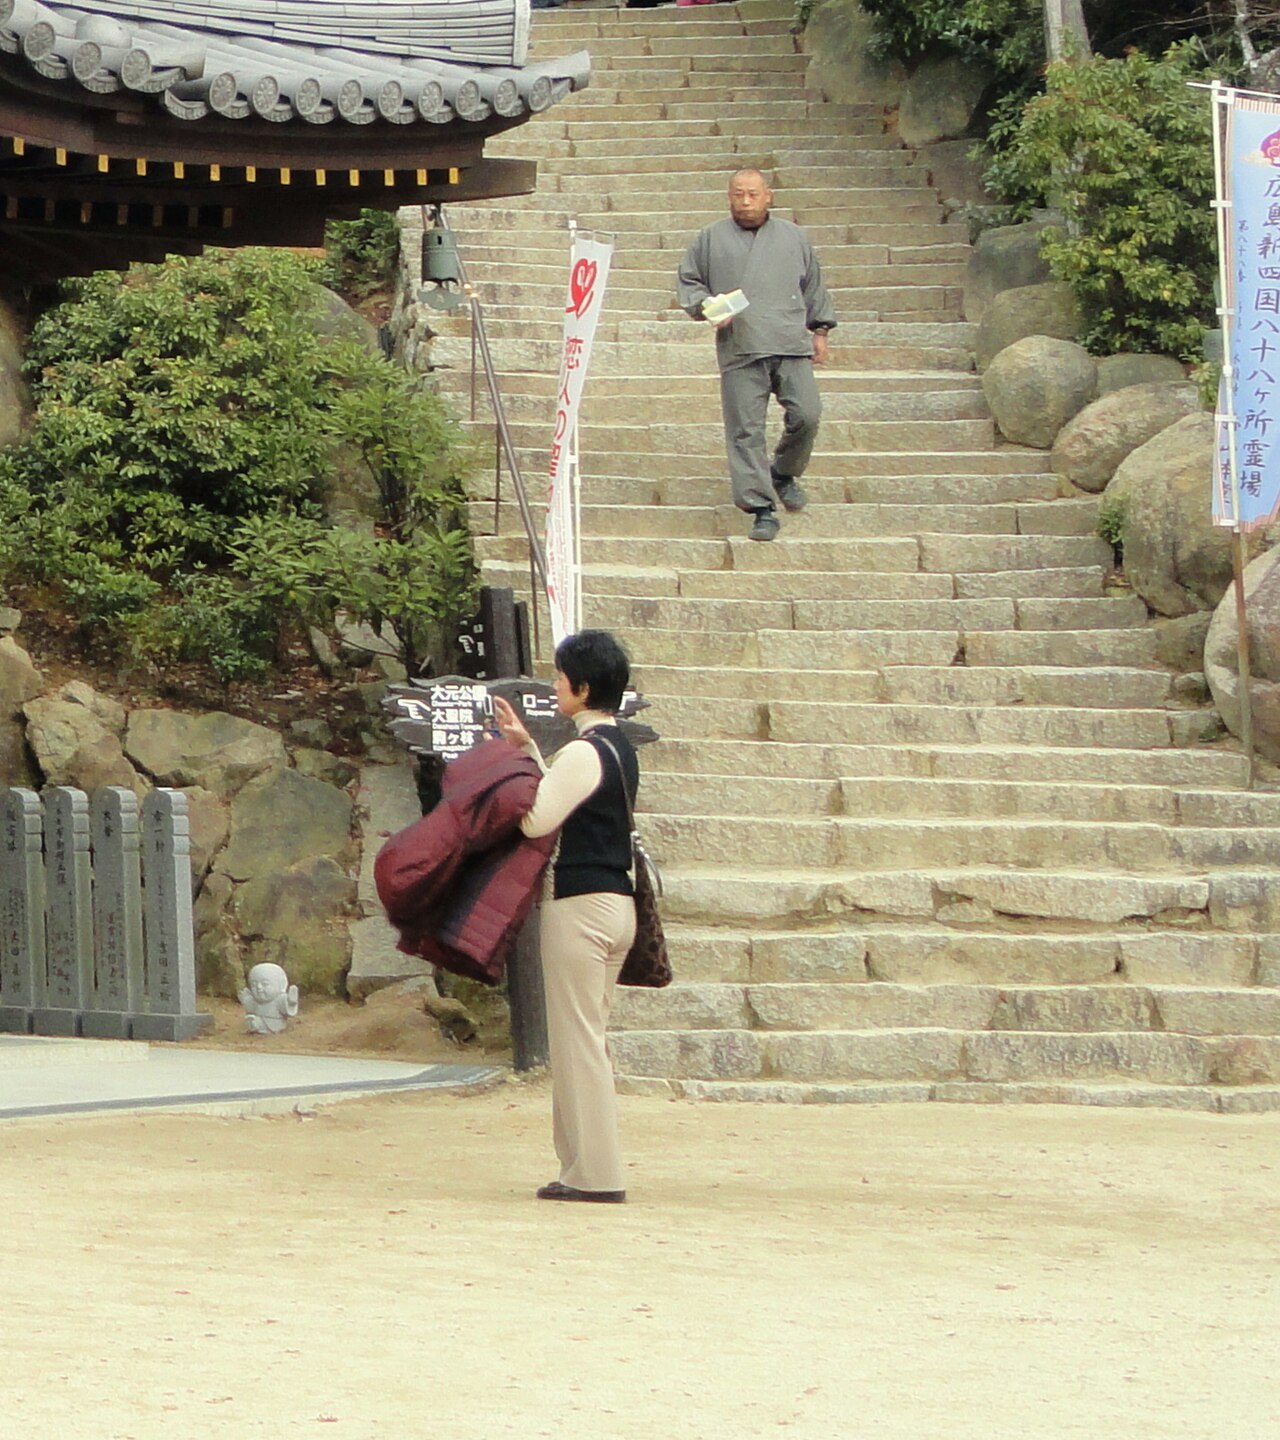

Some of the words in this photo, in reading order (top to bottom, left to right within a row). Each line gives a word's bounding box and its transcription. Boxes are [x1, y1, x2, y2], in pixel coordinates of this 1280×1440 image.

[430, 684, 487, 701] 大元公園
[431, 708, 474, 723] 大聖院
